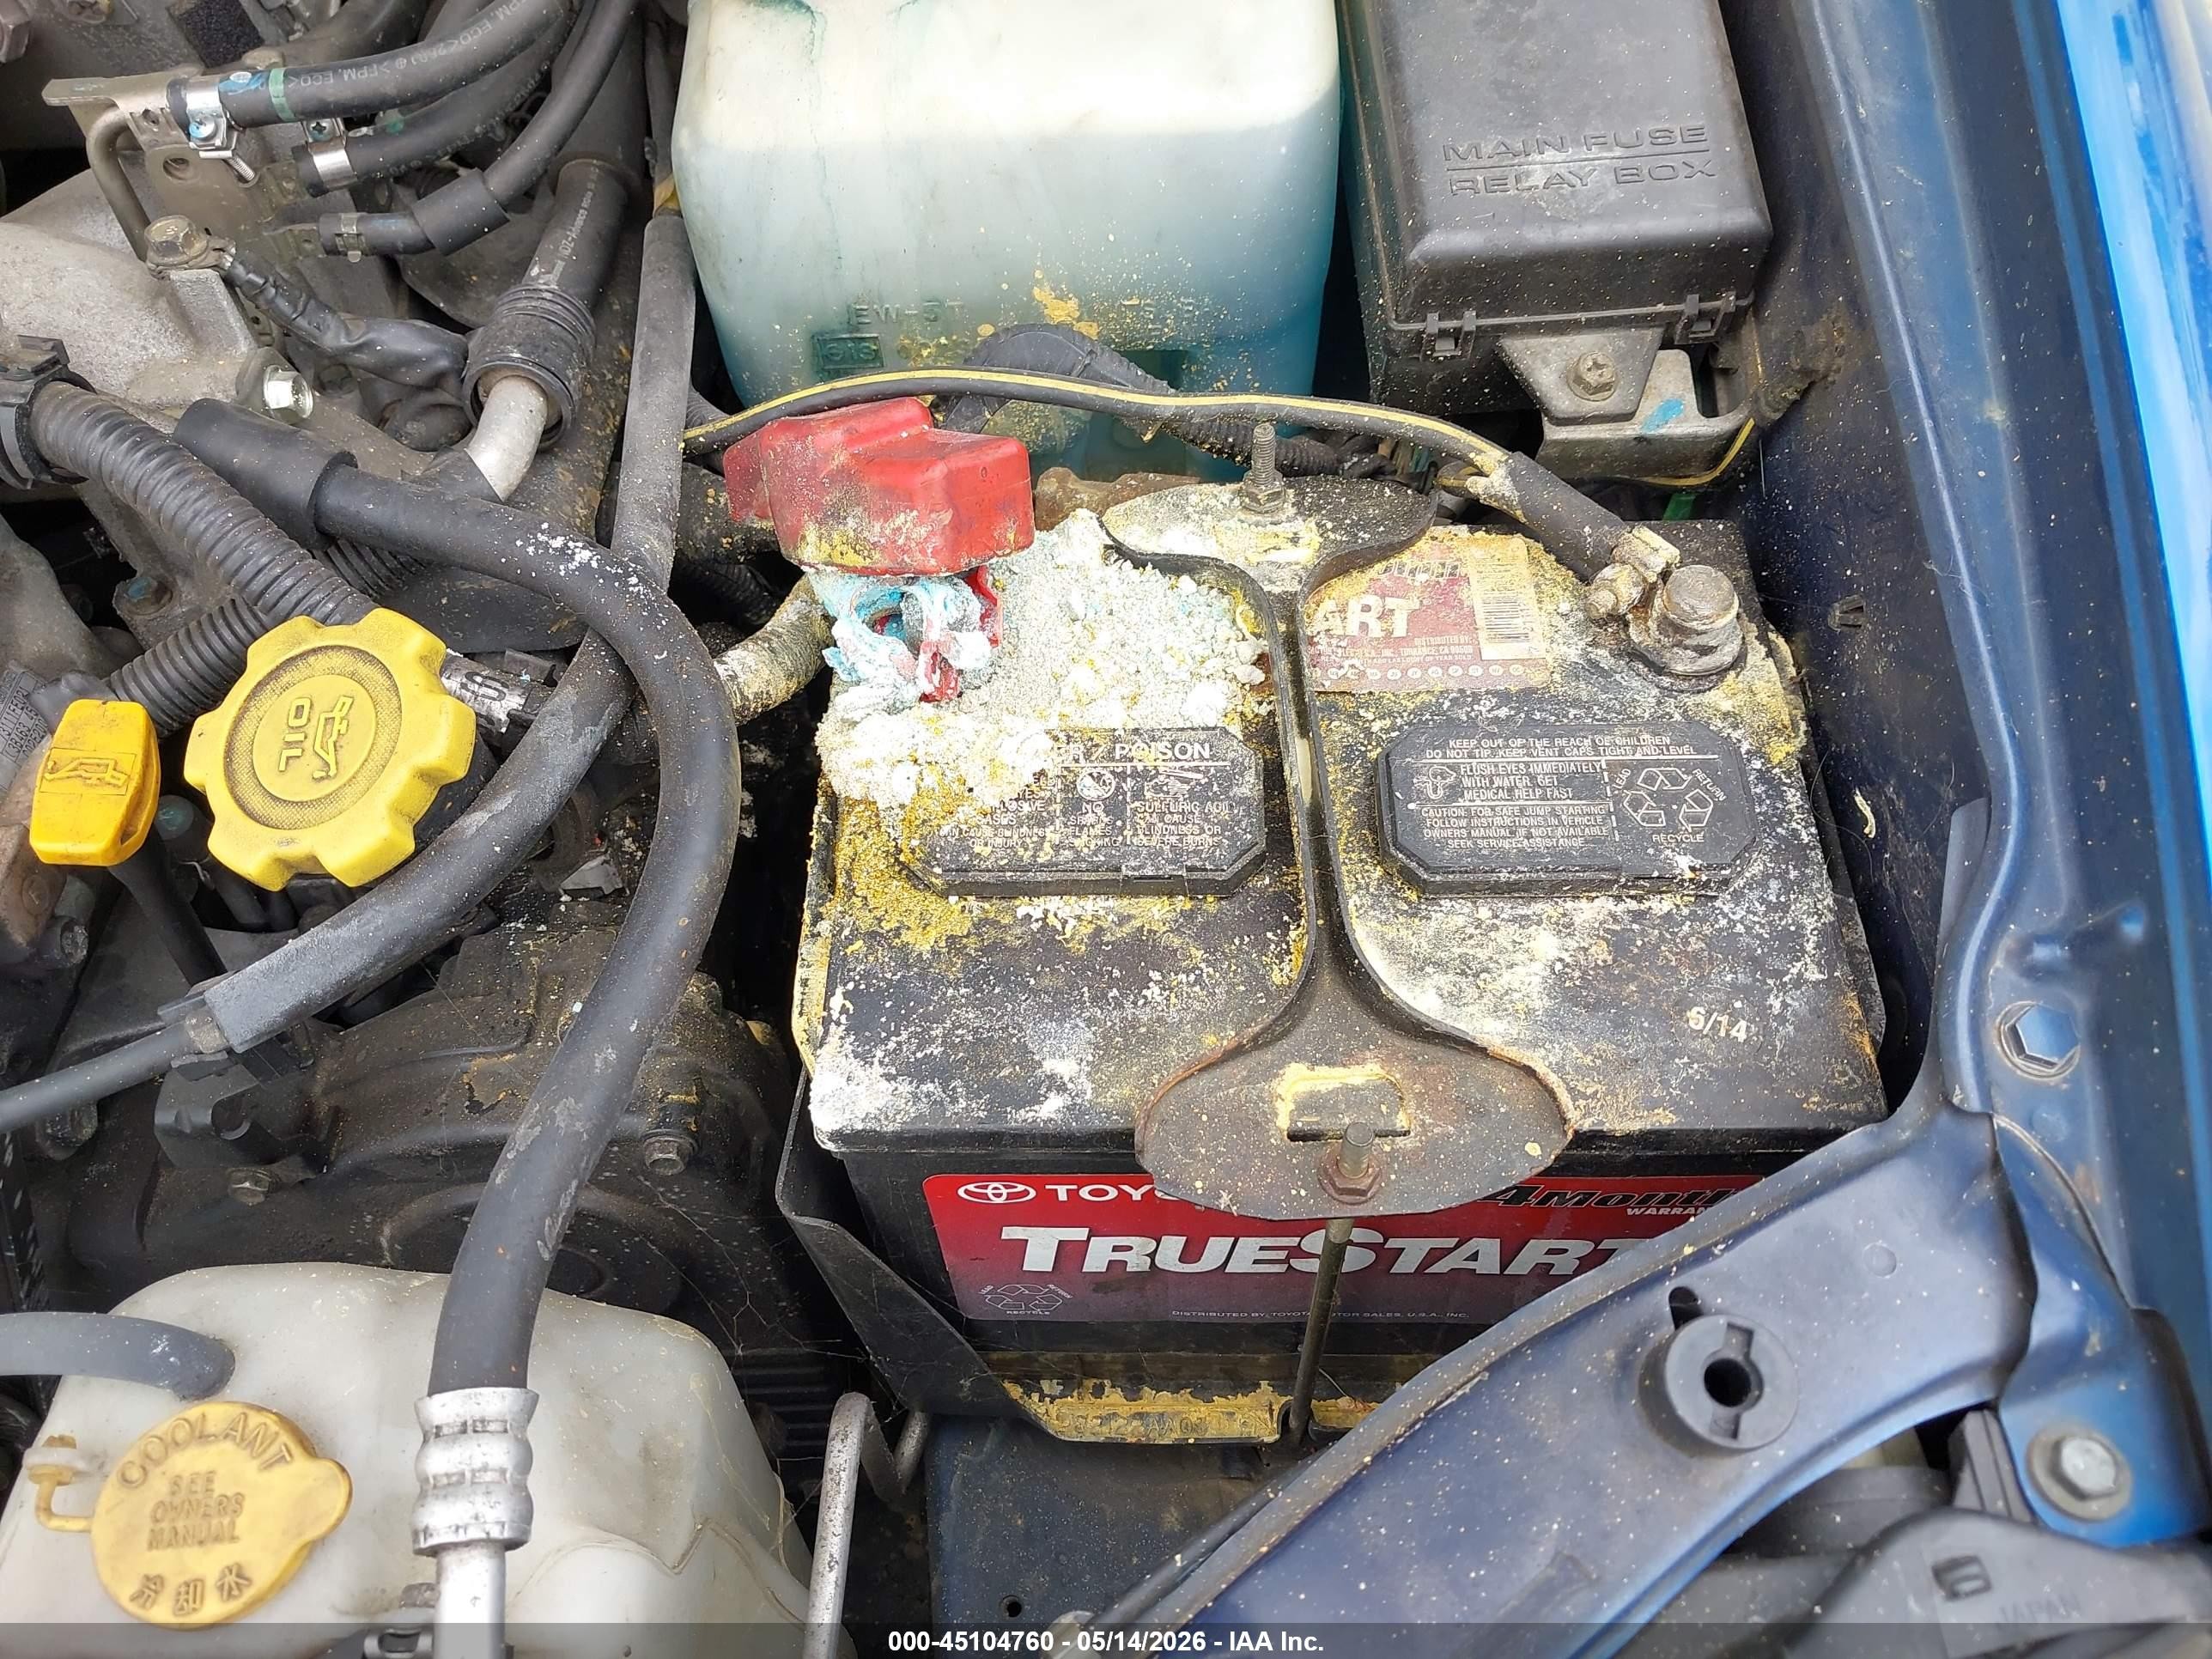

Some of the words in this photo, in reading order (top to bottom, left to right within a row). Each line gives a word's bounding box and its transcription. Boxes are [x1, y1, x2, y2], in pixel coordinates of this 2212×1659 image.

[1443, 135, 1571, 162] MAIN
[1583, 125, 1709, 152] FUSE
[1449, 167, 1597, 196] RELAY
[1613, 159, 1717, 185] BOX
[278, 696, 312, 772] OIL
[1449, 738, 1477, 749] KEEP
[1481, 738, 1503, 748] OUT
[1508, 738, 1527, 748] OF
[1528, 738, 1550, 748] THE
[1554, 737, 1592, 747] REACH
[1614, 736, 1671, 746] CHILDREN
[1116, 742, 1211, 761] POISON
[1425, 750, 1443, 759] DO
[1446, 749, 1469, 759] NOT
[1498, 748, 1527, 758] KEEP
[1531, 747, 1559, 757] VENT
[1564, 746, 1595, 757] CAPS
[1598, 746, 1631, 757] TIGHT
[1635, 745, 1656, 756] AND
[1663, 745, 1698, 756] LEVEL
[1461, 762, 1494, 775] FLUSH
[1501, 762, 1526, 774] EYES
[1530, 761, 1601, 774] IMMEDIATELY
[1461, 776, 1490, 788] WITH
[1537, 775, 1559, 787] GET
[1613, 768, 1632, 790] LEAD
[1692, 768, 1728, 802] RETURN
[1463, 788, 1511, 800] MEDICAL
[1515, 788, 1542, 799] HELP
[1547, 787, 1574, 799] FAST
[1081, 801, 1105, 814] NO
[1137, 801, 1201, 813] SULFURIC
[1471, 807, 1492, 817] FOR
[1495, 806, 1521, 817] SAFE
[1524, 806, 1552, 817] JUMP
[1555, 805, 1606, 816] STARTING
[1164, 815, 1202, 825] CAUSE
[1426, 817, 1468, 828] FOLLOW
[1470, 817, 1545, 828] INSTRUCTIONS
[1547, 817, 1559, 827] IN
[1562, 816, 1603, 826] VEHICLE
[962, 827, 996, 838] CAUSE
[1070, 826, 1114, 836] FLAMES
[1205, 824, 1222, 835] OR
[1516, 827, 1528, 837] IF
[1531, 827, 1553, 837] NOT
[1557, 826, 1610, 837] AVAILABLE
[969, 838, 985, 848] OR
[987, 837, 1024, 848] INJURY
[1182, 836, 1222, 847] BURNS
[1448, 839, 1474, 849] SEEK
[1476, 838, 1518, 848] SERVICE
[1652, 833, 1705, 843] RECYCLE
[1687, 1006, 1747, 1043] 6/14
[1044, 1183, 1180, 1201] TOY
[1626, 1206, 1707, 1216] WARRAN
[117, 1411, 295, 1489] COOLANT
[169, 1469, 216, 1496] SEE
[150, 1492, 246, 1524] OWNERS
[147, 1519, 240, 1552] MANUAL
[128, 1562, 252, 1617] 冷却水
